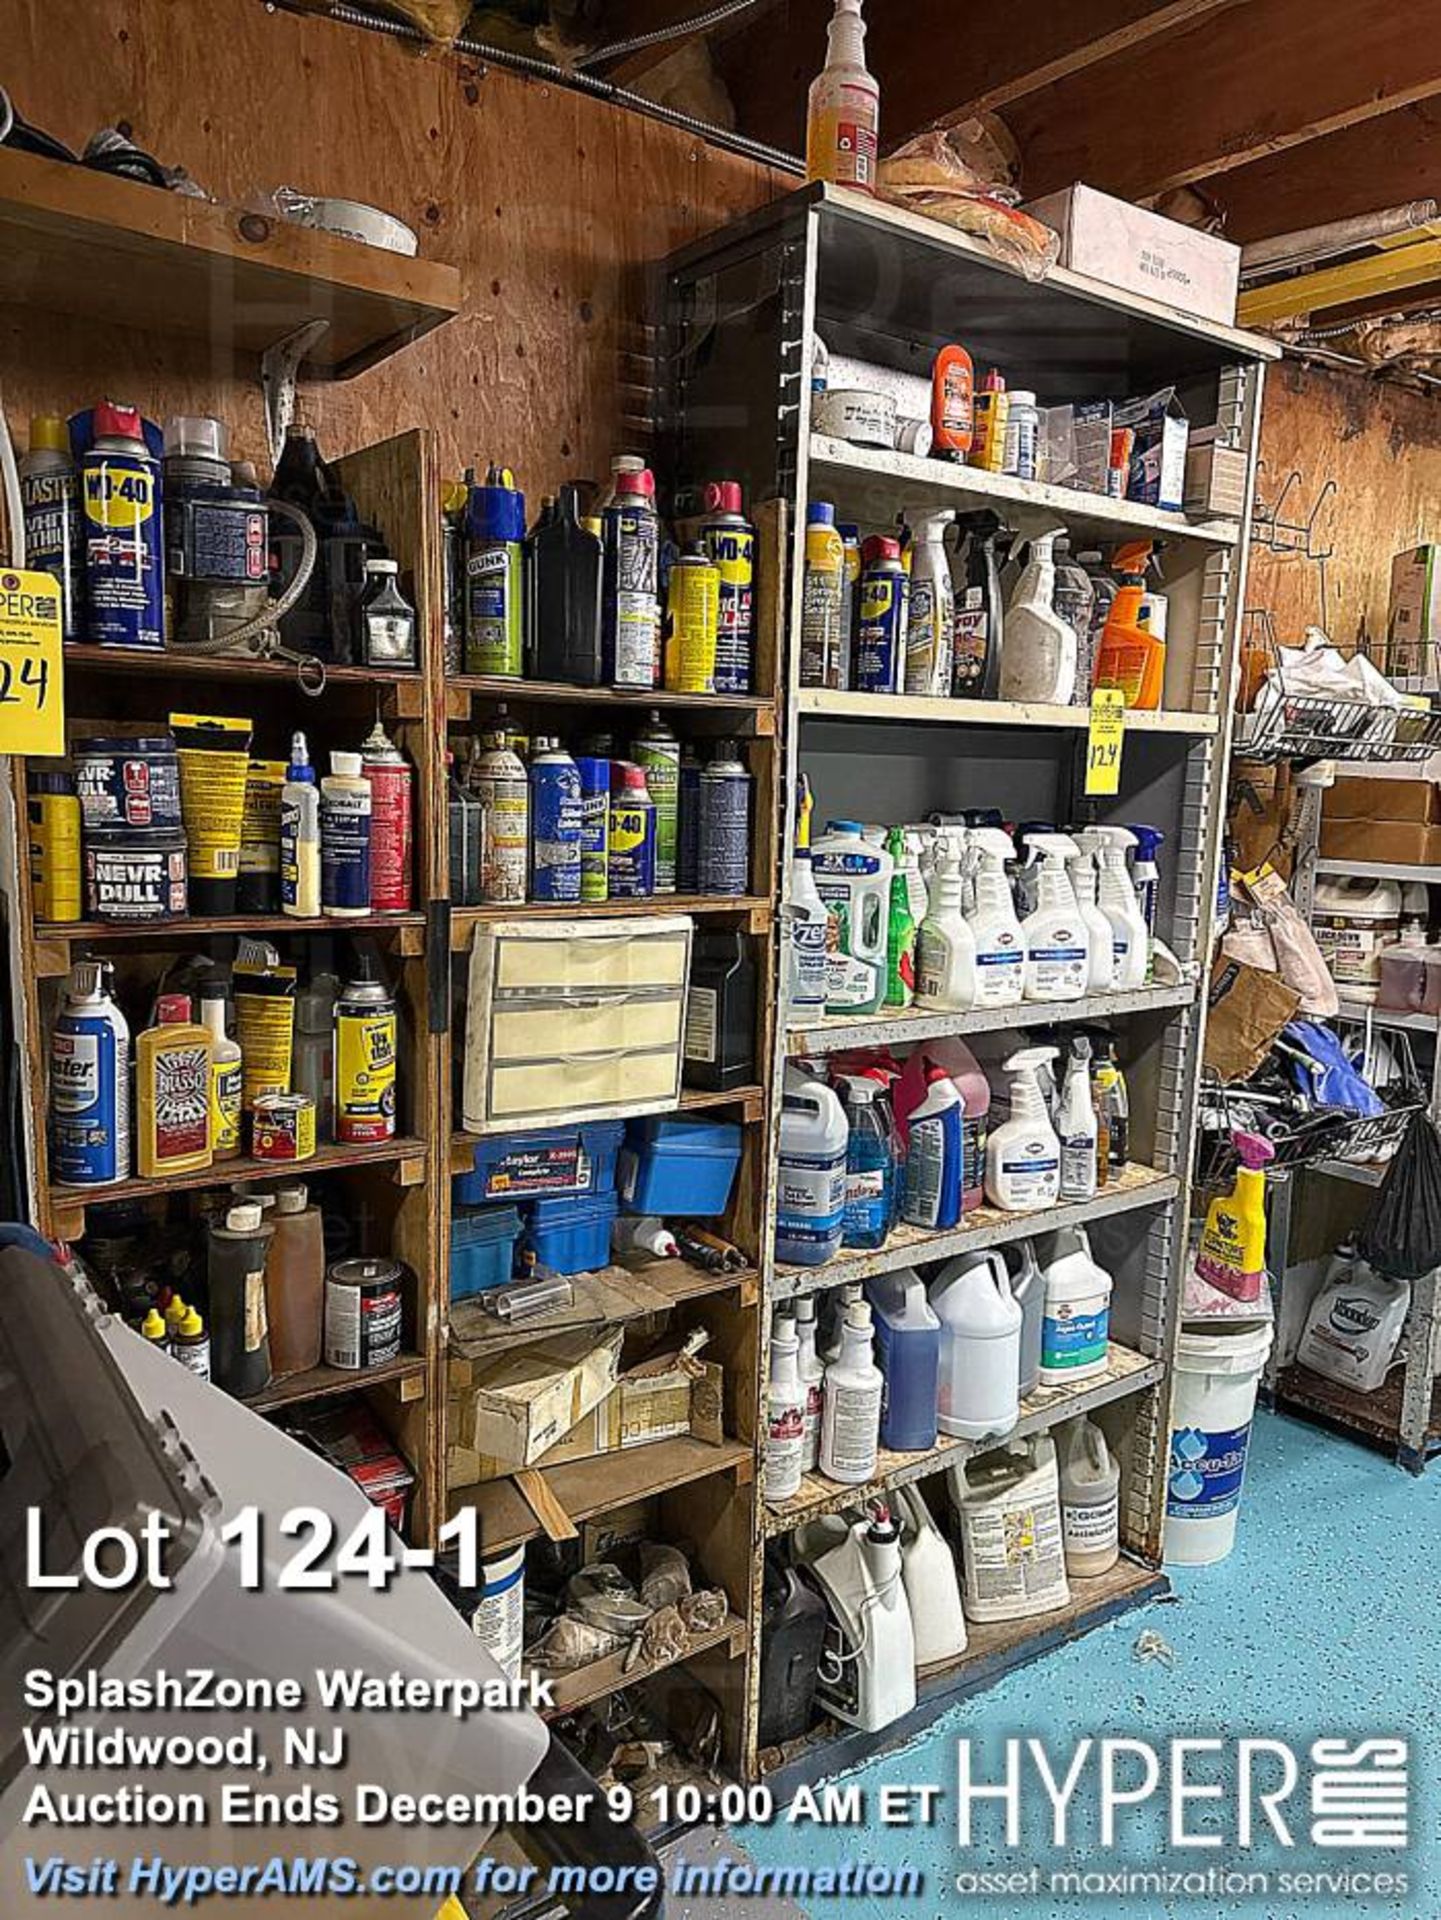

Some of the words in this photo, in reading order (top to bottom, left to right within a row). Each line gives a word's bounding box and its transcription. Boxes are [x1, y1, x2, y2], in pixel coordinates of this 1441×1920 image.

[87, 474, 148, 504] WD-40
[468, 552, 505, 574] GUNK
[97, 865, 168, 883] NEVR-
[100, 884, 161, 903] DULL
